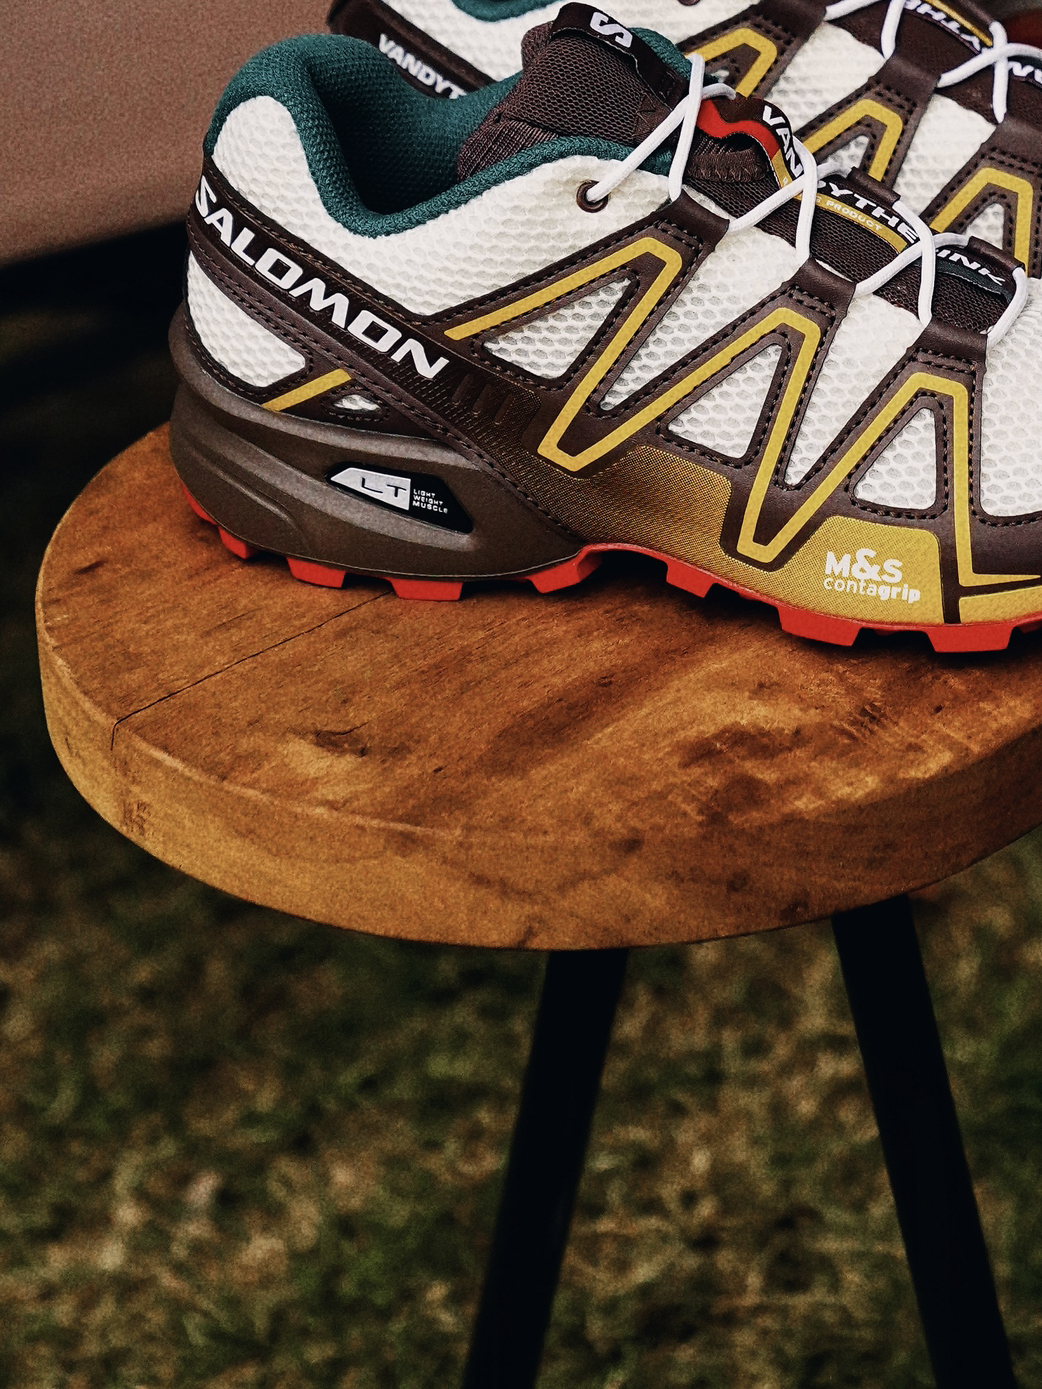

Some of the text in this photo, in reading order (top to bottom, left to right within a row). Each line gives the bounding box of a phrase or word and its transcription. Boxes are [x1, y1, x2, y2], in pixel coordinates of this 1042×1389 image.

[826, 196, 883, 231] PRODUCT
[195, 175, 450, 379] SALOMON
[412, 500, 448, 514] MUSCLE
[413, 488, 436, 499] LIGHT
[413, 495, 444, 506] WEIGHT
[825, 548, 903, 584] M&S
[823, 577, 921, 604] contagrip
